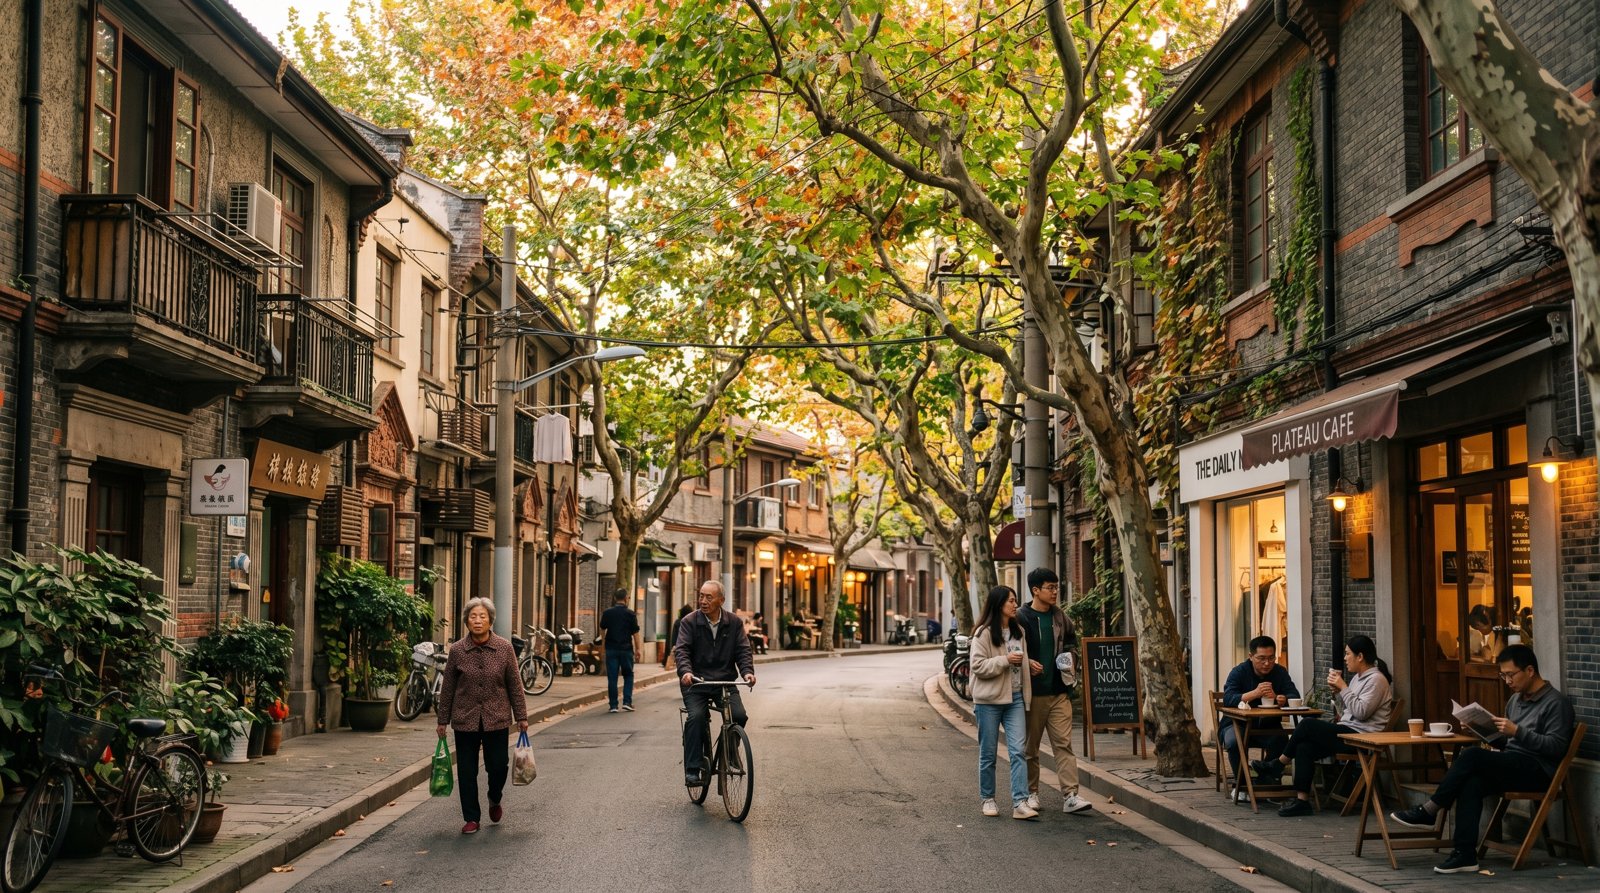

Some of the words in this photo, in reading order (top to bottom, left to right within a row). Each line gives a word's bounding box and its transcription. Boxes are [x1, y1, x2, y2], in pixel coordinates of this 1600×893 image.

[1272, 421, 1320, 454] PLATEAU
[1323, 411, 1354, 442] CAFE
[1196, 458, 1211, 480] THE
[1212, 450, 1237, 477] DAILY
[1098, 644, 1123, 657] THE
[1093, 657, 1129, 670] DAILY
[1097, 671, 1128, 684] NOOK
